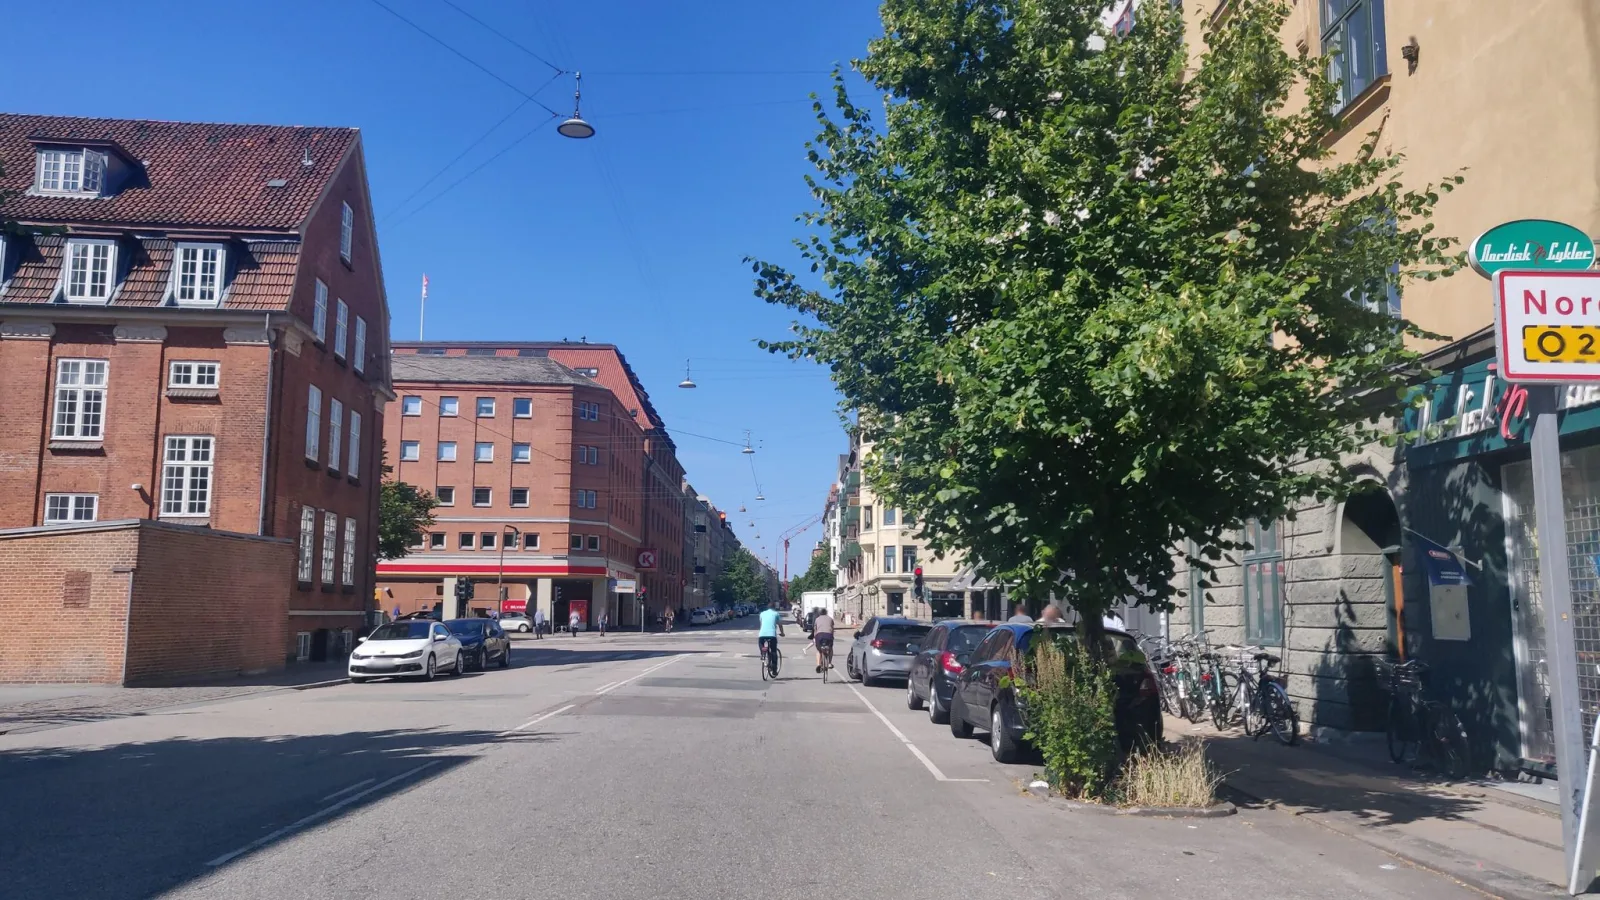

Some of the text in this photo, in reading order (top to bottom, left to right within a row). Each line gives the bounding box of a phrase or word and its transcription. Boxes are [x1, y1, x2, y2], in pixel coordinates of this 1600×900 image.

[1479, 242, 1593, 263] Nordisk Cykler
[1523, 289, 1600, 316] Nor
